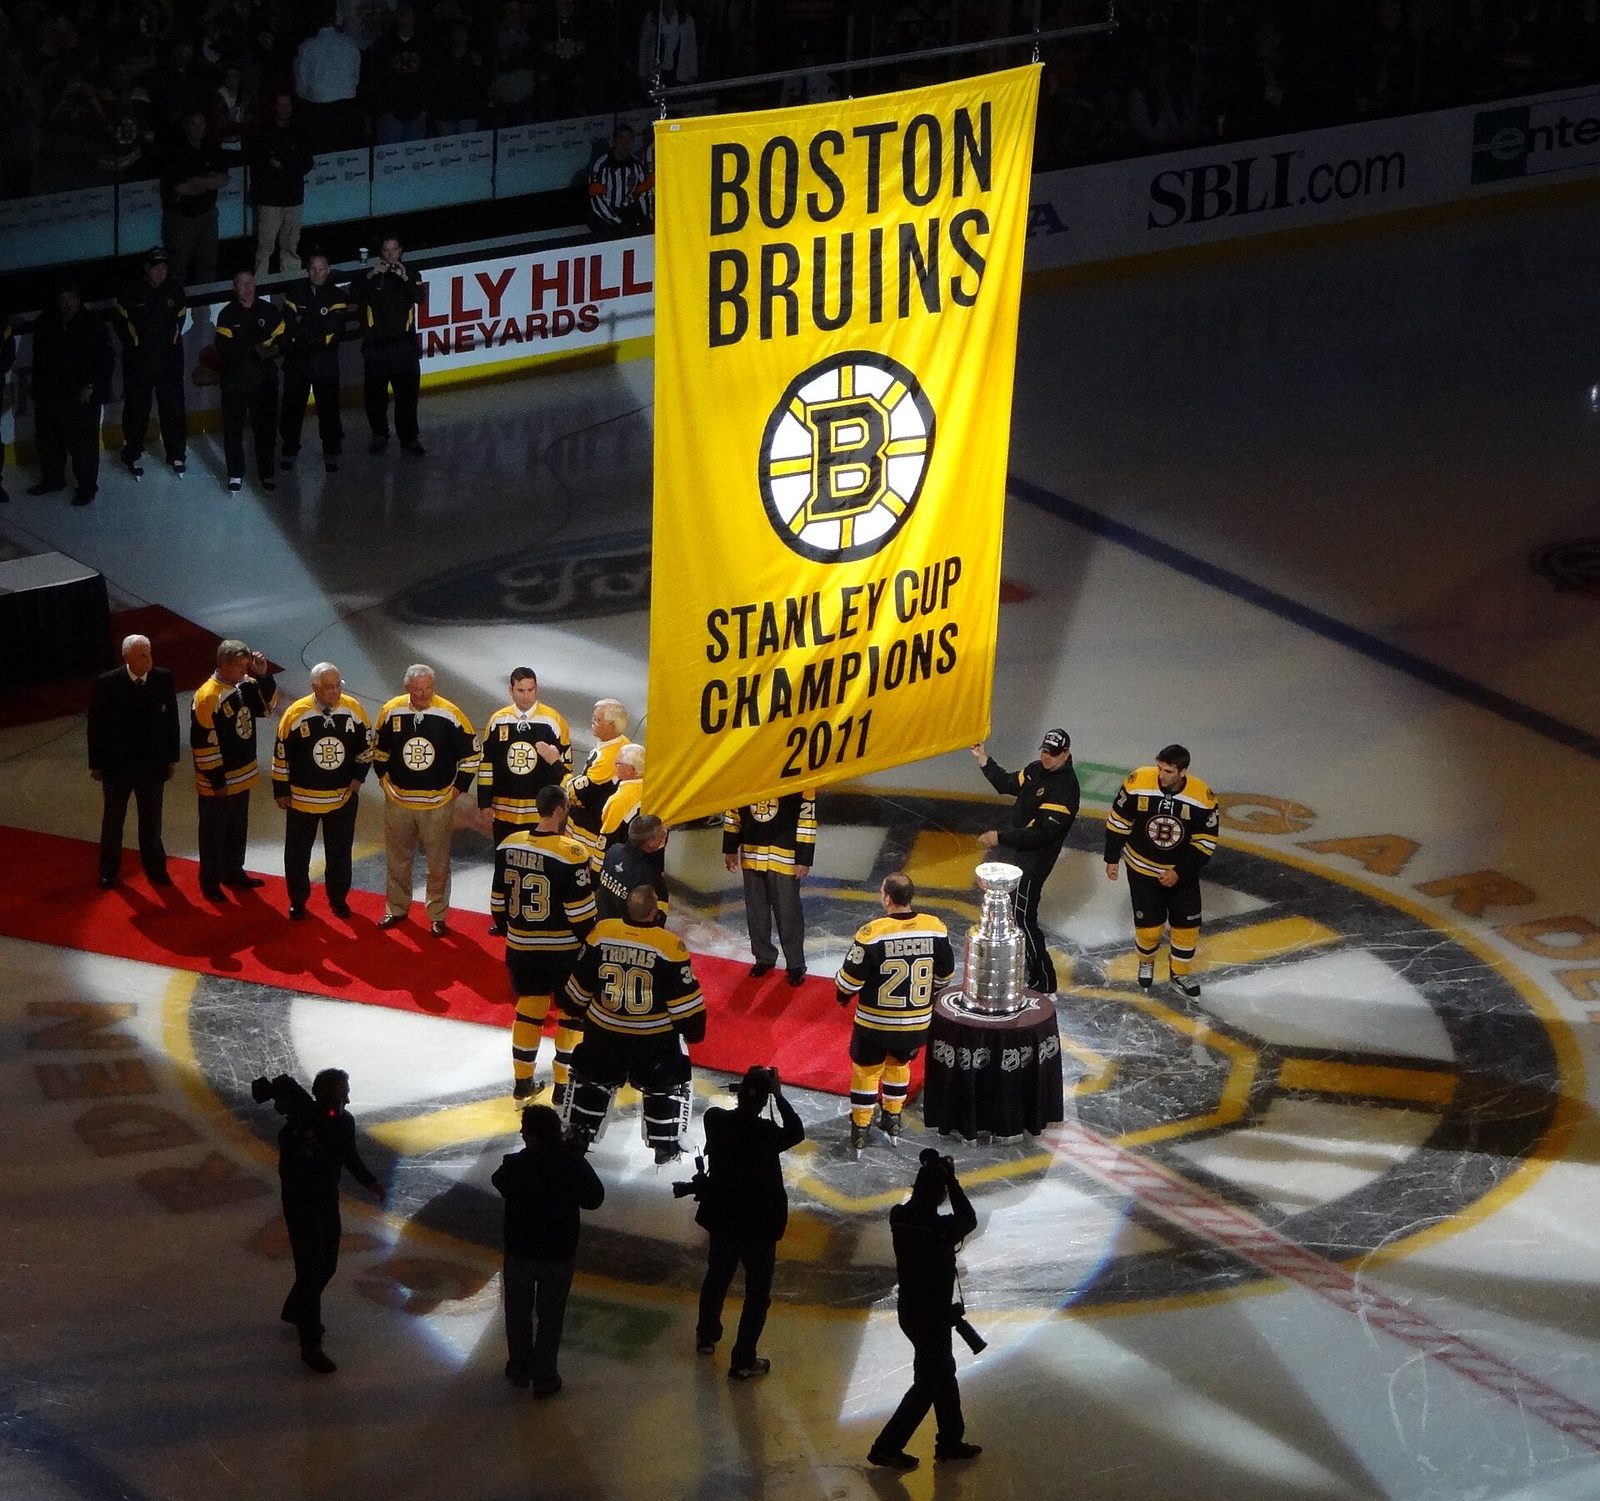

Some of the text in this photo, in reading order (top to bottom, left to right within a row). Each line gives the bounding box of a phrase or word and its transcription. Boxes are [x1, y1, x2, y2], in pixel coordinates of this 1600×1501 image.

[709, 101, 992, 237] BOSTON
[1147, 151, 1405, 230] SBLI.com
[417, 249, 653, 330] LLY HILL
[708, 208, 991, 349] BRUINS
[416, 304, 600, 360] INEYARDS
[706, 556, 962, 664] STANLEY CUP
[700, 623, 959, 735] CHAMPIONS
[780, 709, 873, 780] 2011
[799, 802, 816, 819] 21
[600, 943, 657, 969] THOMAS
[877, 957, 934, 1008] 28
[884, 938, 934, 958] RECCHI
[598, 962, 654, 1015] 30
